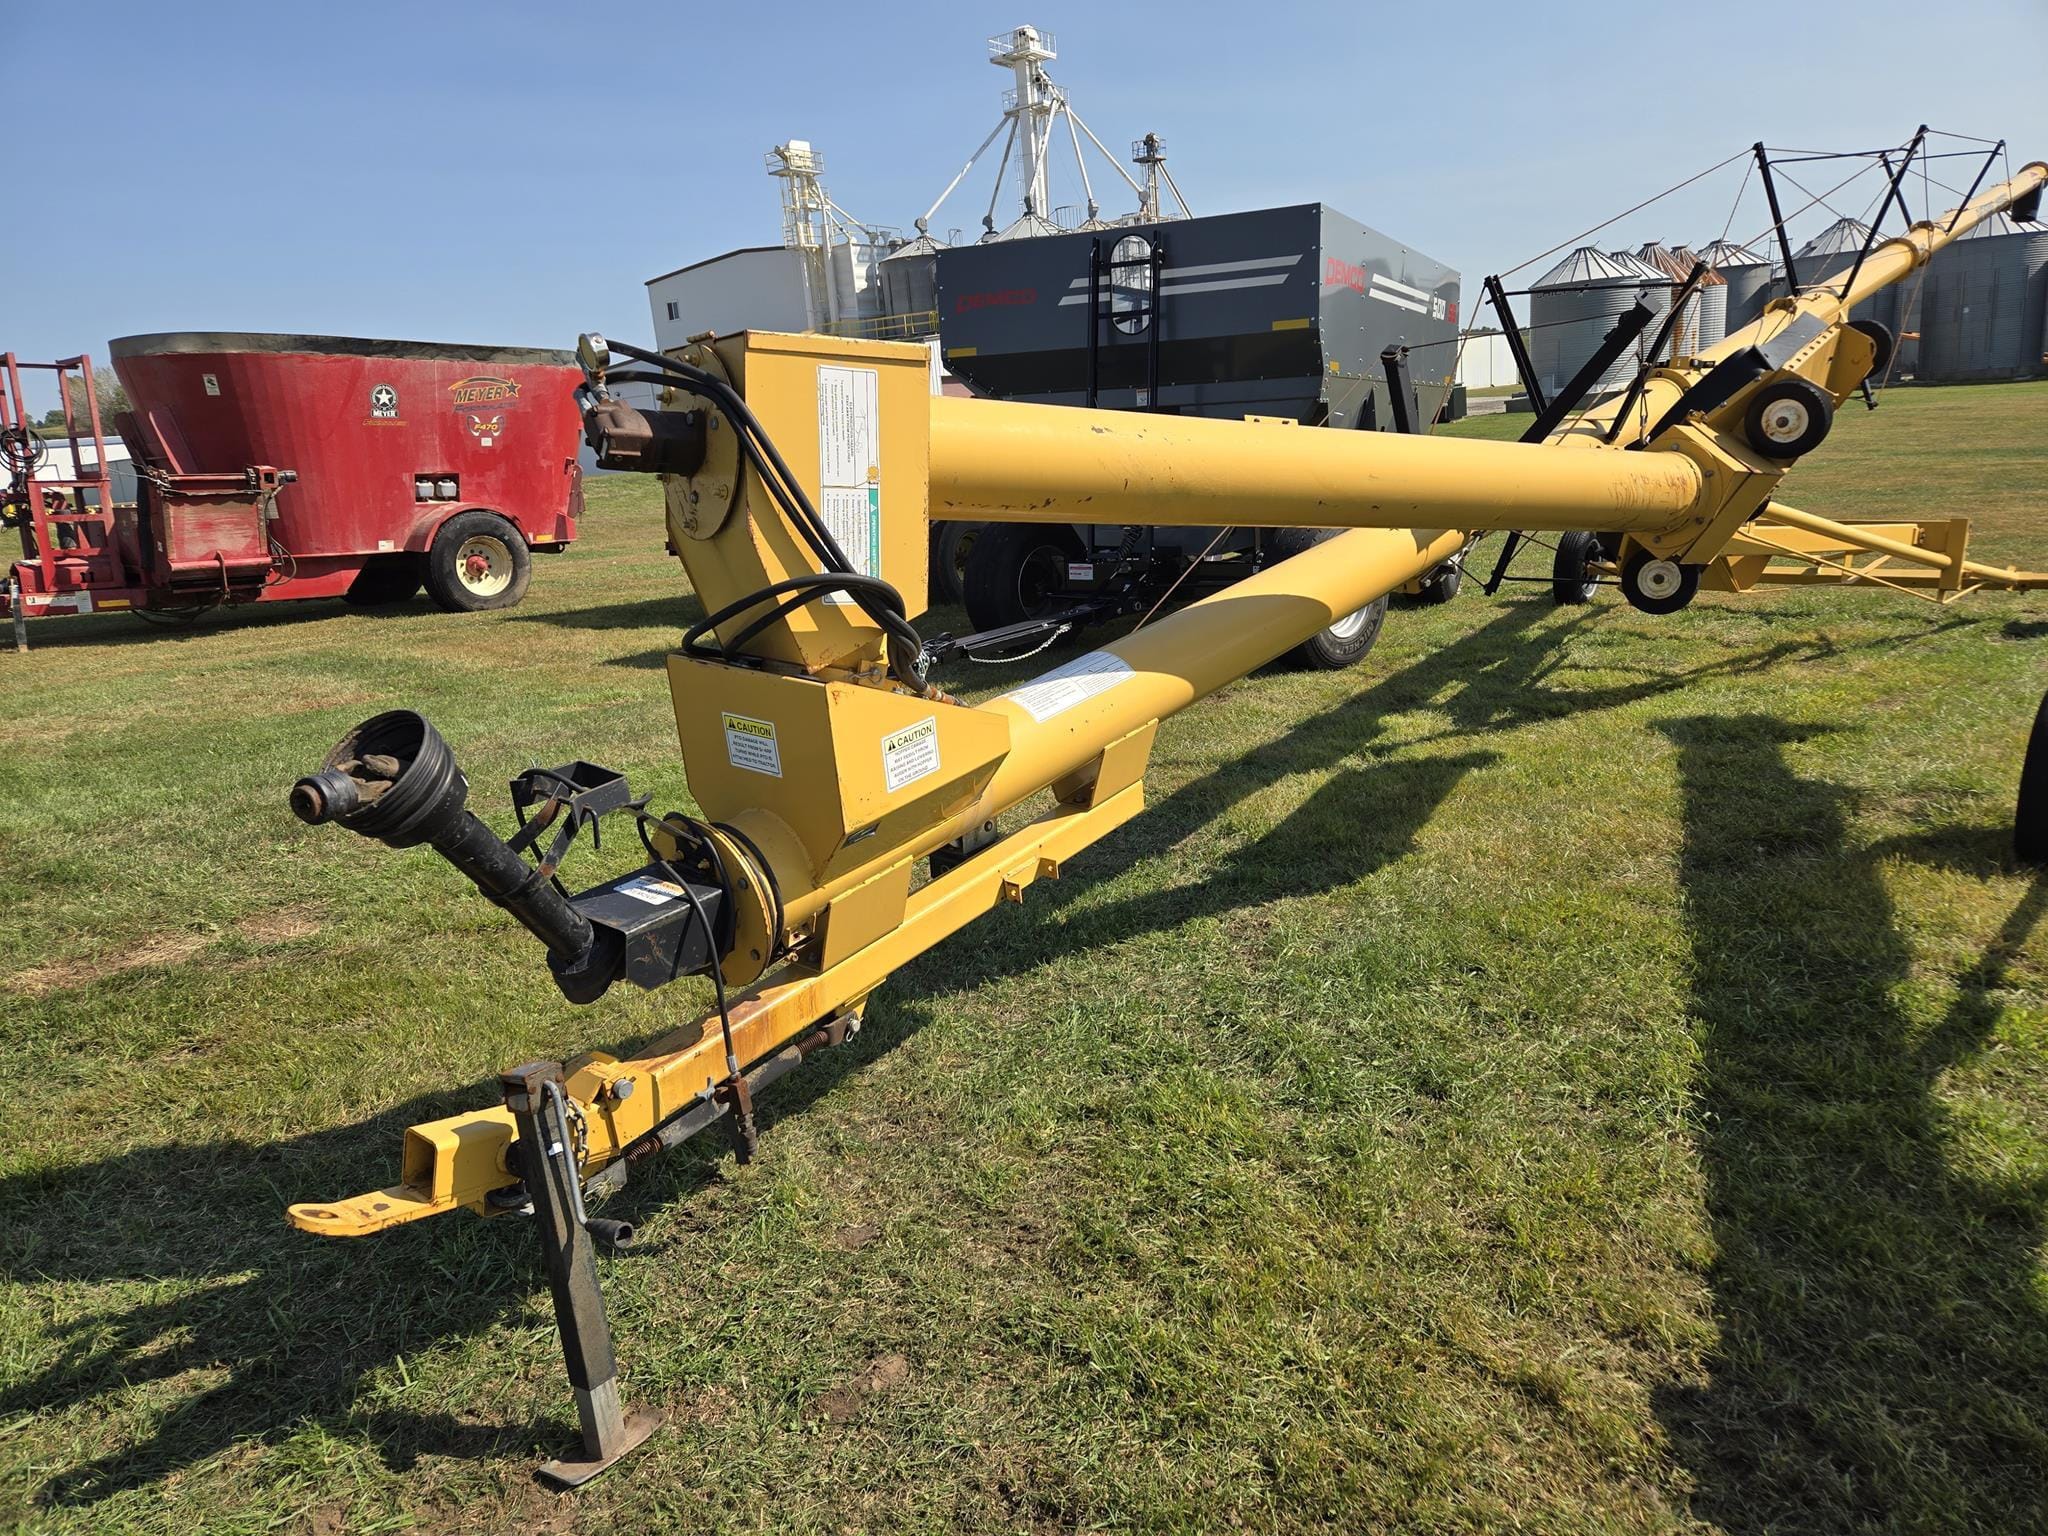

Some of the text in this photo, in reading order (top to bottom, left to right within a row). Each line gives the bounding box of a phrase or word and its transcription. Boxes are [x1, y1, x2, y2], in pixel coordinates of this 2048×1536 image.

[1325, 257, 1365, 294] DEMCO
[955, 288, 1037, 315] DEMCO
[454, 386, 504, 404] MEYER
[736, 722, 771, 736] CAUTION
[897, 725, 931, 746] CAUTION
